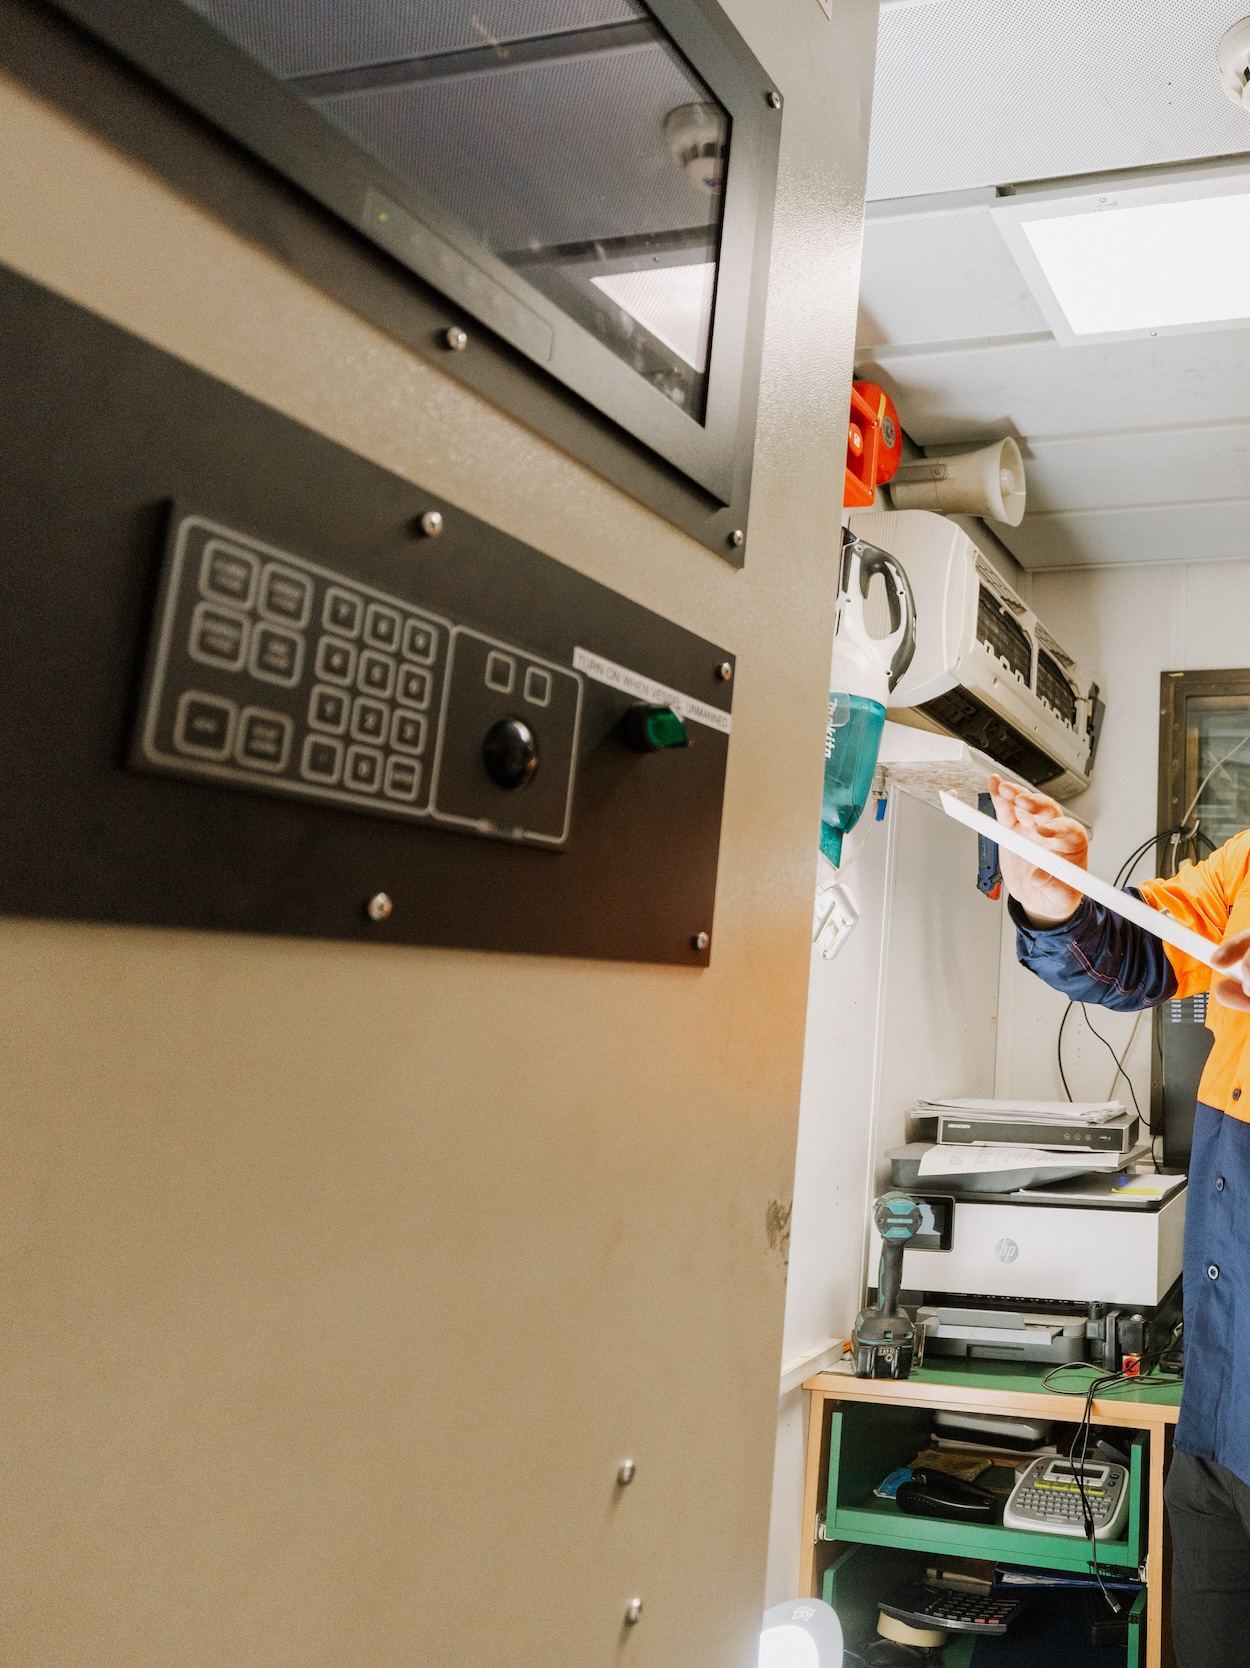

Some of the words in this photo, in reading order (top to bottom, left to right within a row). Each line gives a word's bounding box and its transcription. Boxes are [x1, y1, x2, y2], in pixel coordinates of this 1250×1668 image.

[578, 653, 604, 676] TURN
[605, 665, 620, 682] ON
[622, 674, 649, 697] WHEN
